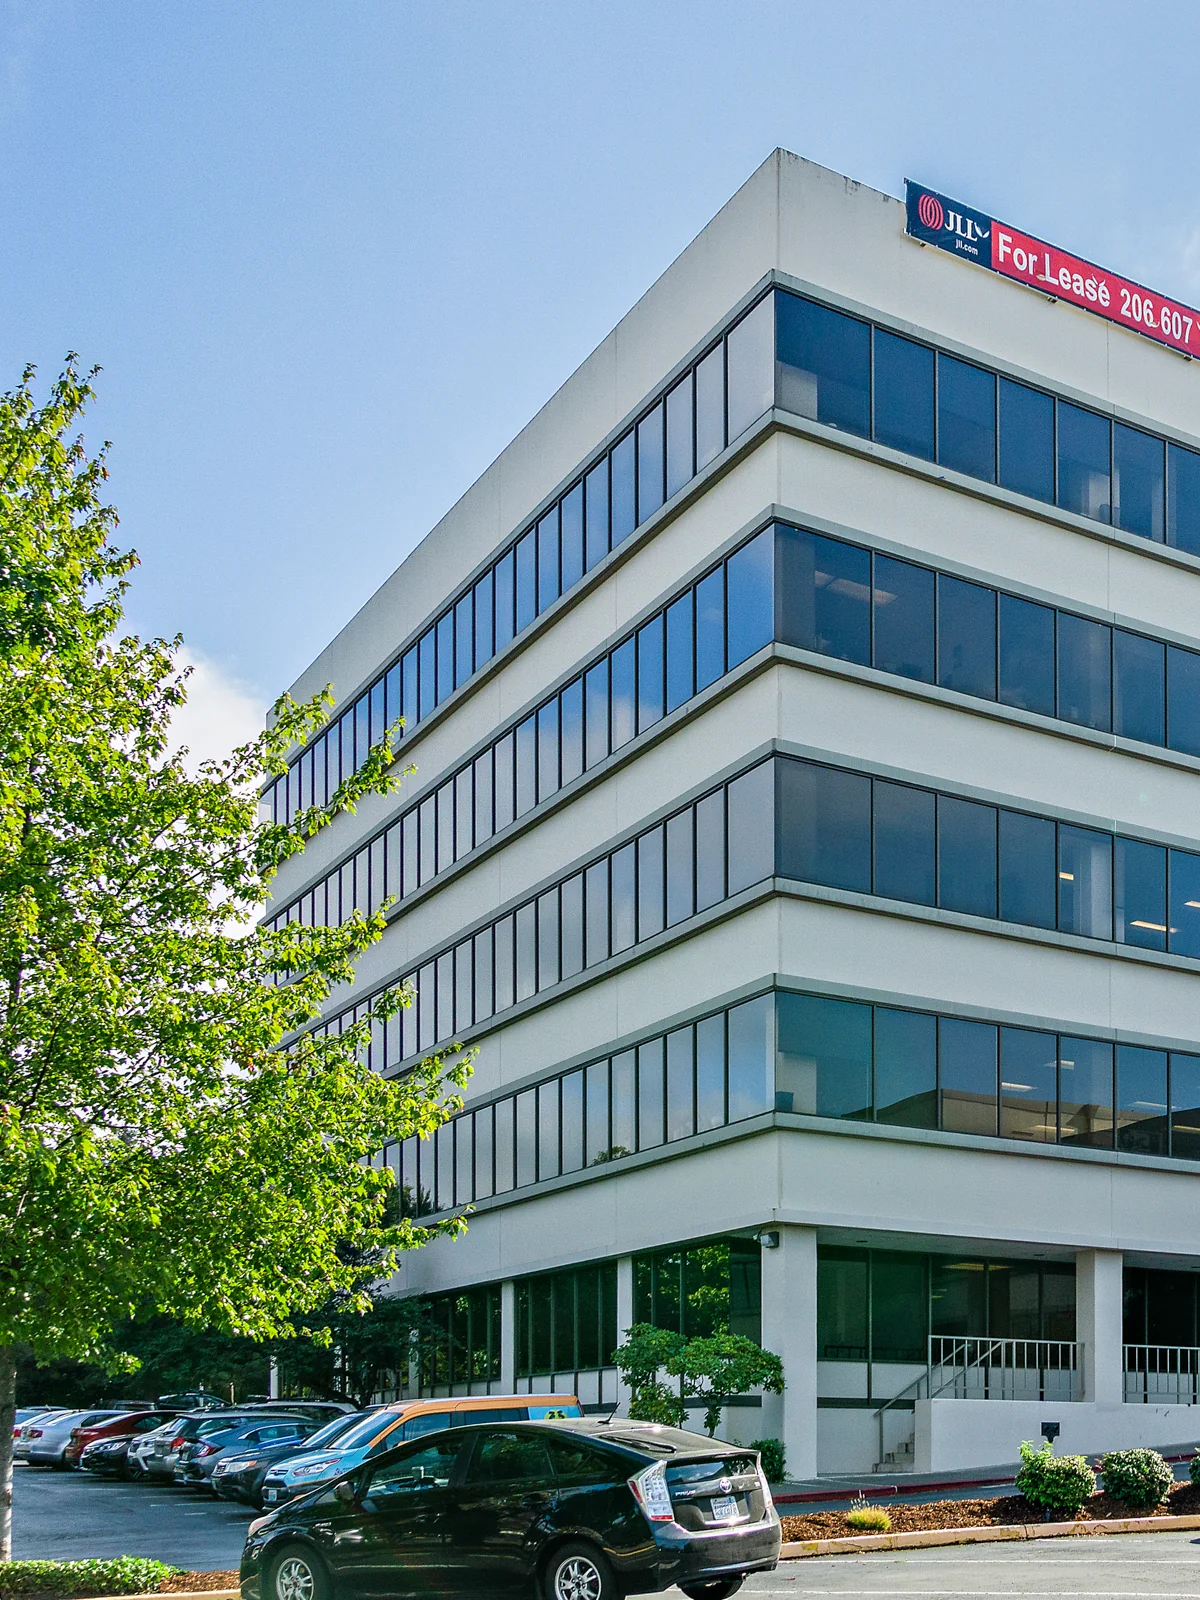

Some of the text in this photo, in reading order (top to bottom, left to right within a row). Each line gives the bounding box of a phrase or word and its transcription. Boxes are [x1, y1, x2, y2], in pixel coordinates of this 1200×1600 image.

[944, 209, 978, 242] JLL
[955, 238, 979, 256] jll.com
[998, 231, 1039, 276] For
[1044, 252, 1111, 308] Lease
[1160, 306, 1193, 344] 607
